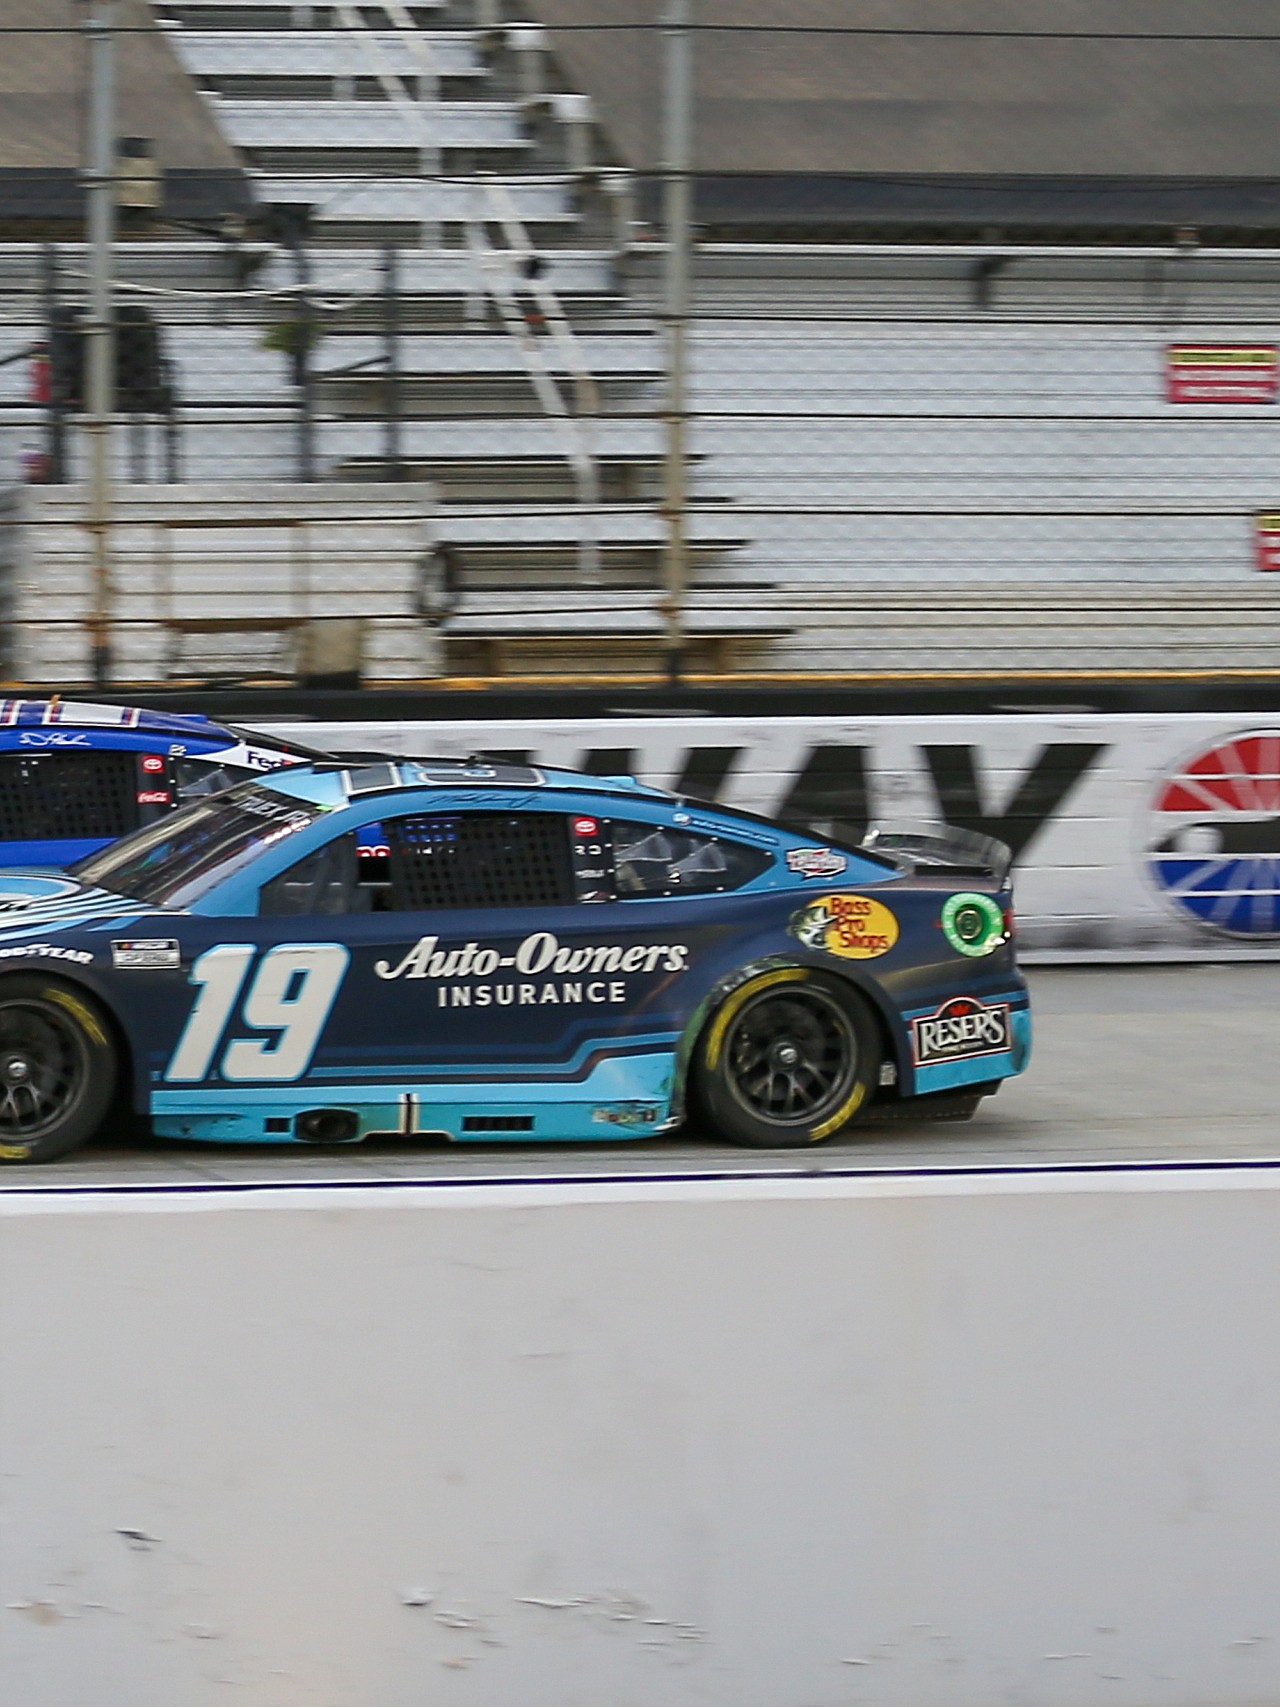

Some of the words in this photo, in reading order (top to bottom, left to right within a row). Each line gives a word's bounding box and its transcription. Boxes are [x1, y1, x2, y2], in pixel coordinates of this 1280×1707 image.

[829, 896, 872, 916] Bass
[835, 916, 866, 932] Pro
[839, 930, 890, 953] Shops
[374, 931, 689, 980] Auto-Owners
[437, 981, 626, 1008] INSURANCE
[163, 942, 352, 1082] 19
[919, 1010, 1006, 1058] RESER'S
